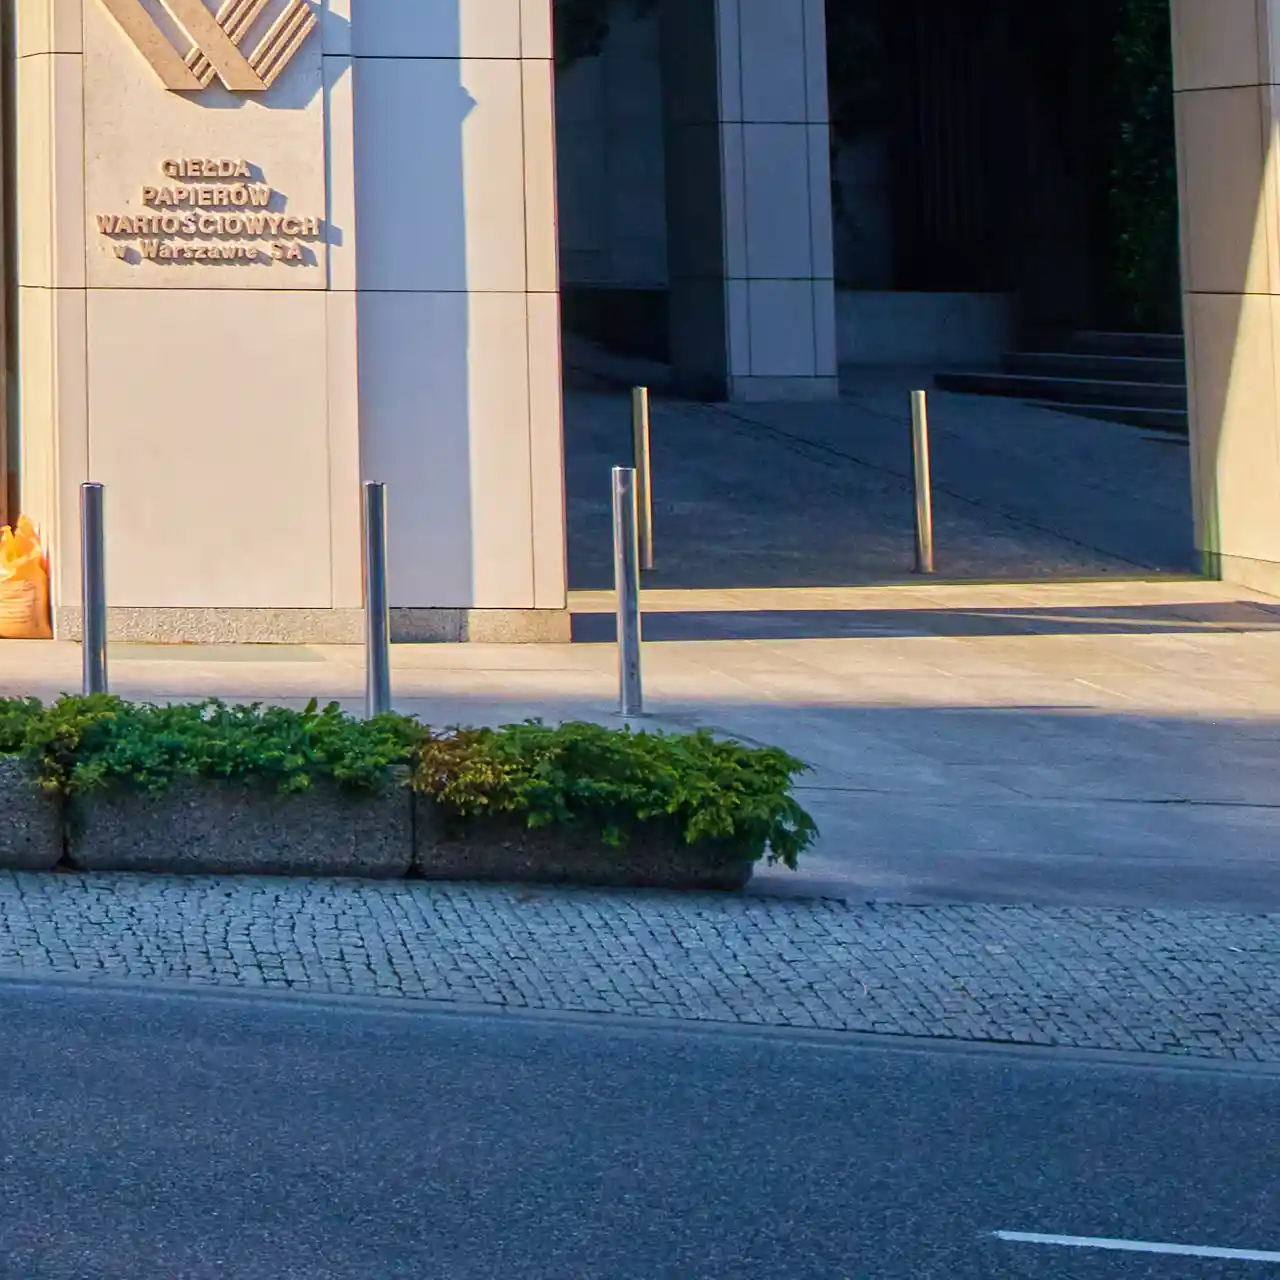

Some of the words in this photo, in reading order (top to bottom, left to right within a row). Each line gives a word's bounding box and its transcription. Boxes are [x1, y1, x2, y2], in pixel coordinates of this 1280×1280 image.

[160, 157, 252, 178] GIEŁDA
[141, 182, 271, 207] PAPIERÓW
[95, 212, 320, 236] WARTOŚCIOWYCH
[141, 239, 258, 260] Warszawie
